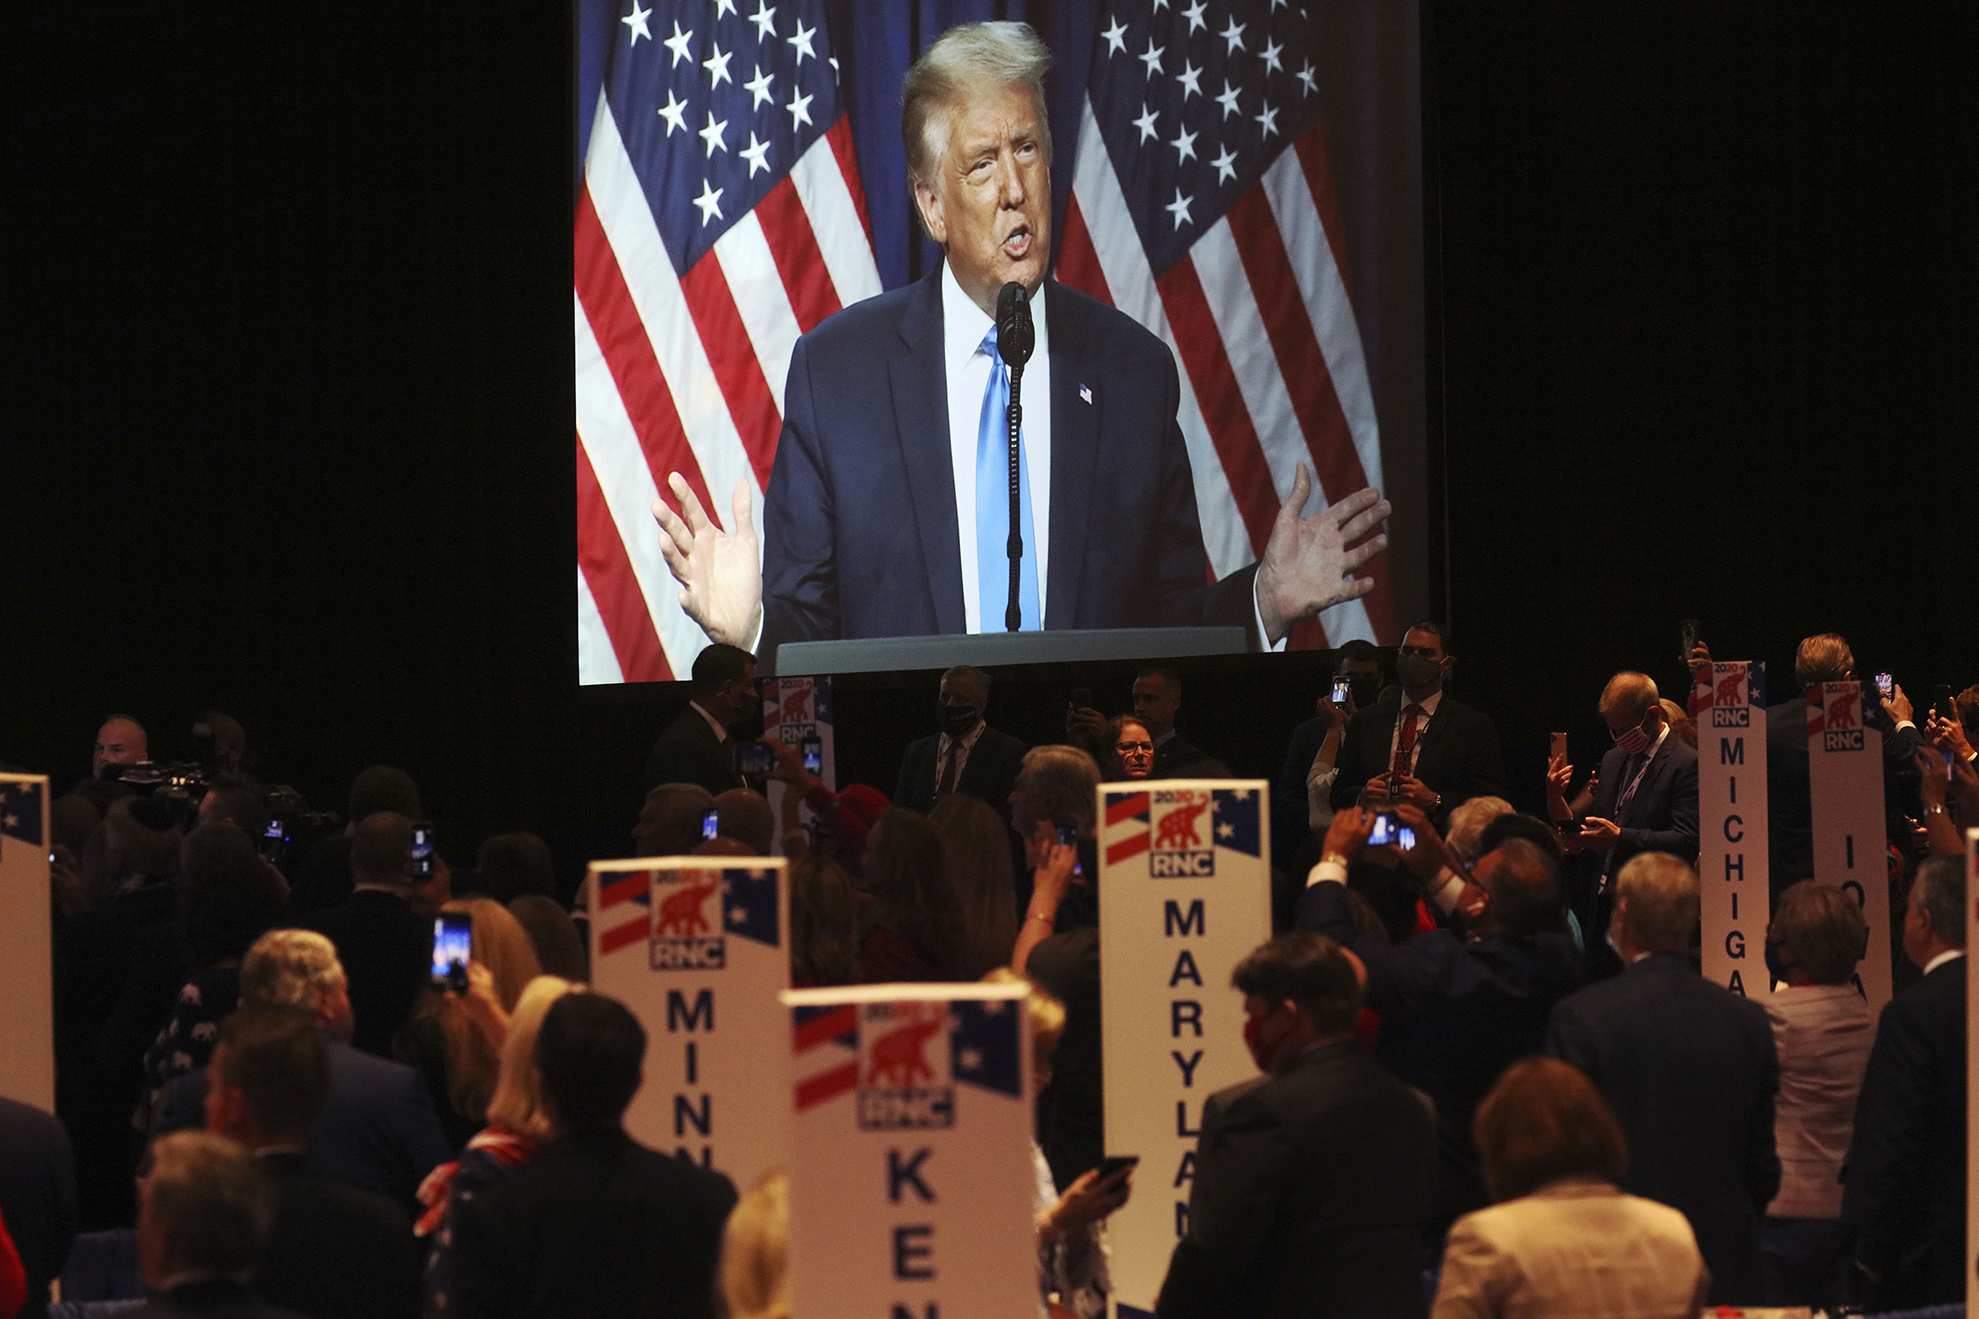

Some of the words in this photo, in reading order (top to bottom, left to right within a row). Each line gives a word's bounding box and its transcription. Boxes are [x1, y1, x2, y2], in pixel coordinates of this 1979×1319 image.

[1714, 663, 1738, 673] 2020
[1825, 684, 1851, 694] 2020
[1714, 709, 1748, 726] RNC
[1825, 731, 1863, 750] RNC
[1152, 853, 1212, 876] RNC
[1720, 737, 1746, 998] MICHIGA
